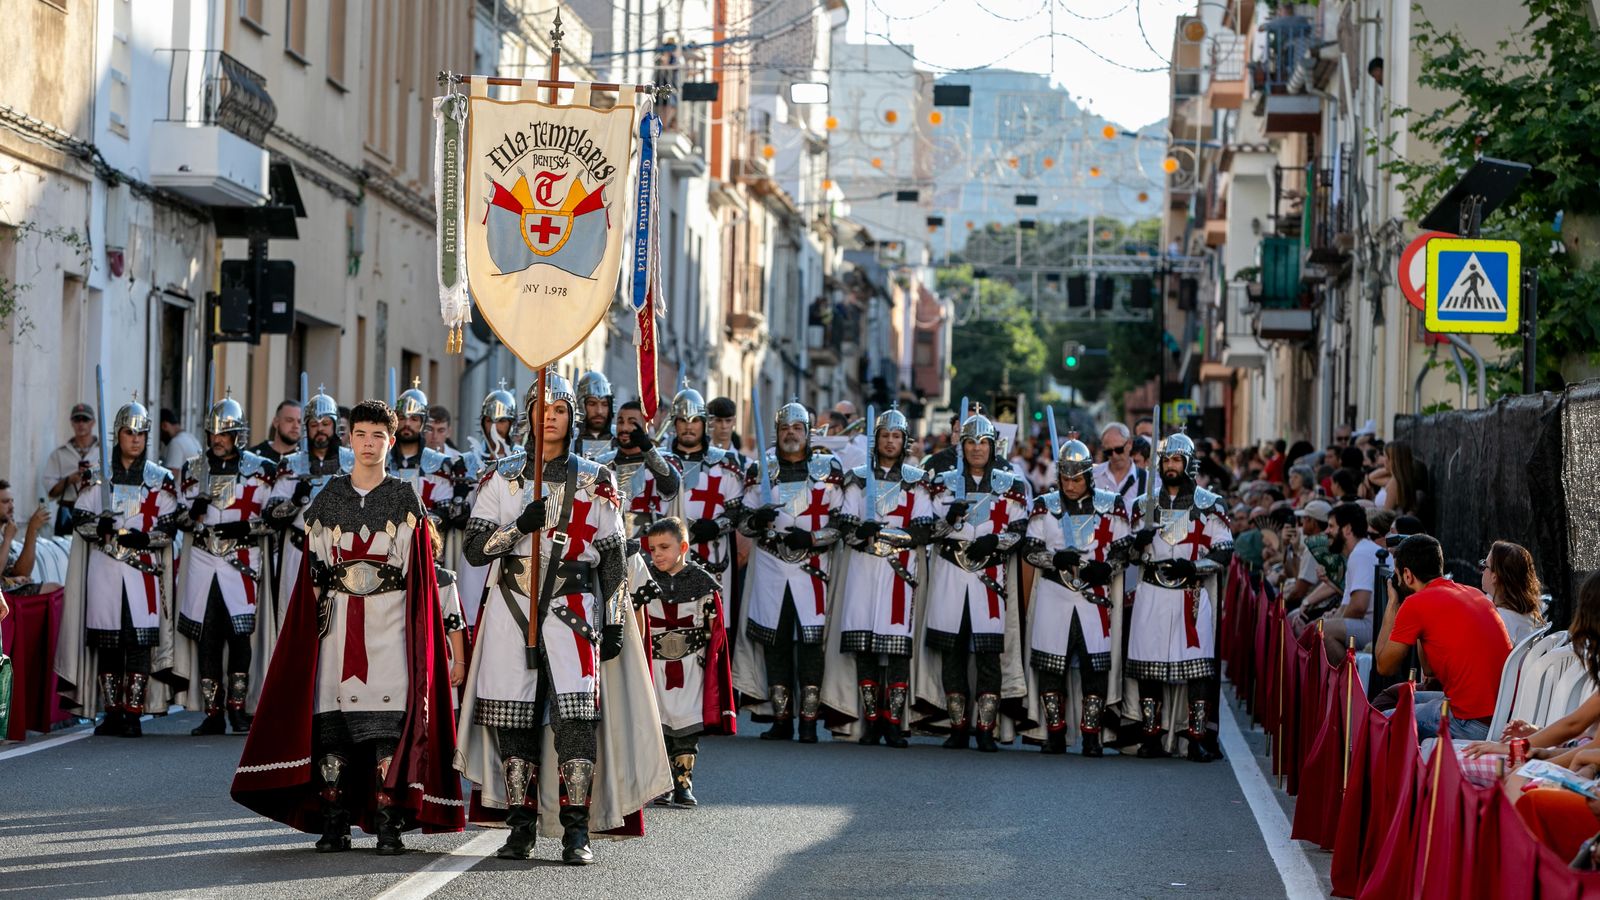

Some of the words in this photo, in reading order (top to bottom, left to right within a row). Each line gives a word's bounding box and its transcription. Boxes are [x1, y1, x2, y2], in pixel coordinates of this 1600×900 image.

[446, 138, 457, 211] Capitania
[640, 159, 651, 231] Capitania
[445, 218, 456, 253] 2019
[637, 238, 648, 272] 2014
[544, 285, 568, 297] 1.978
